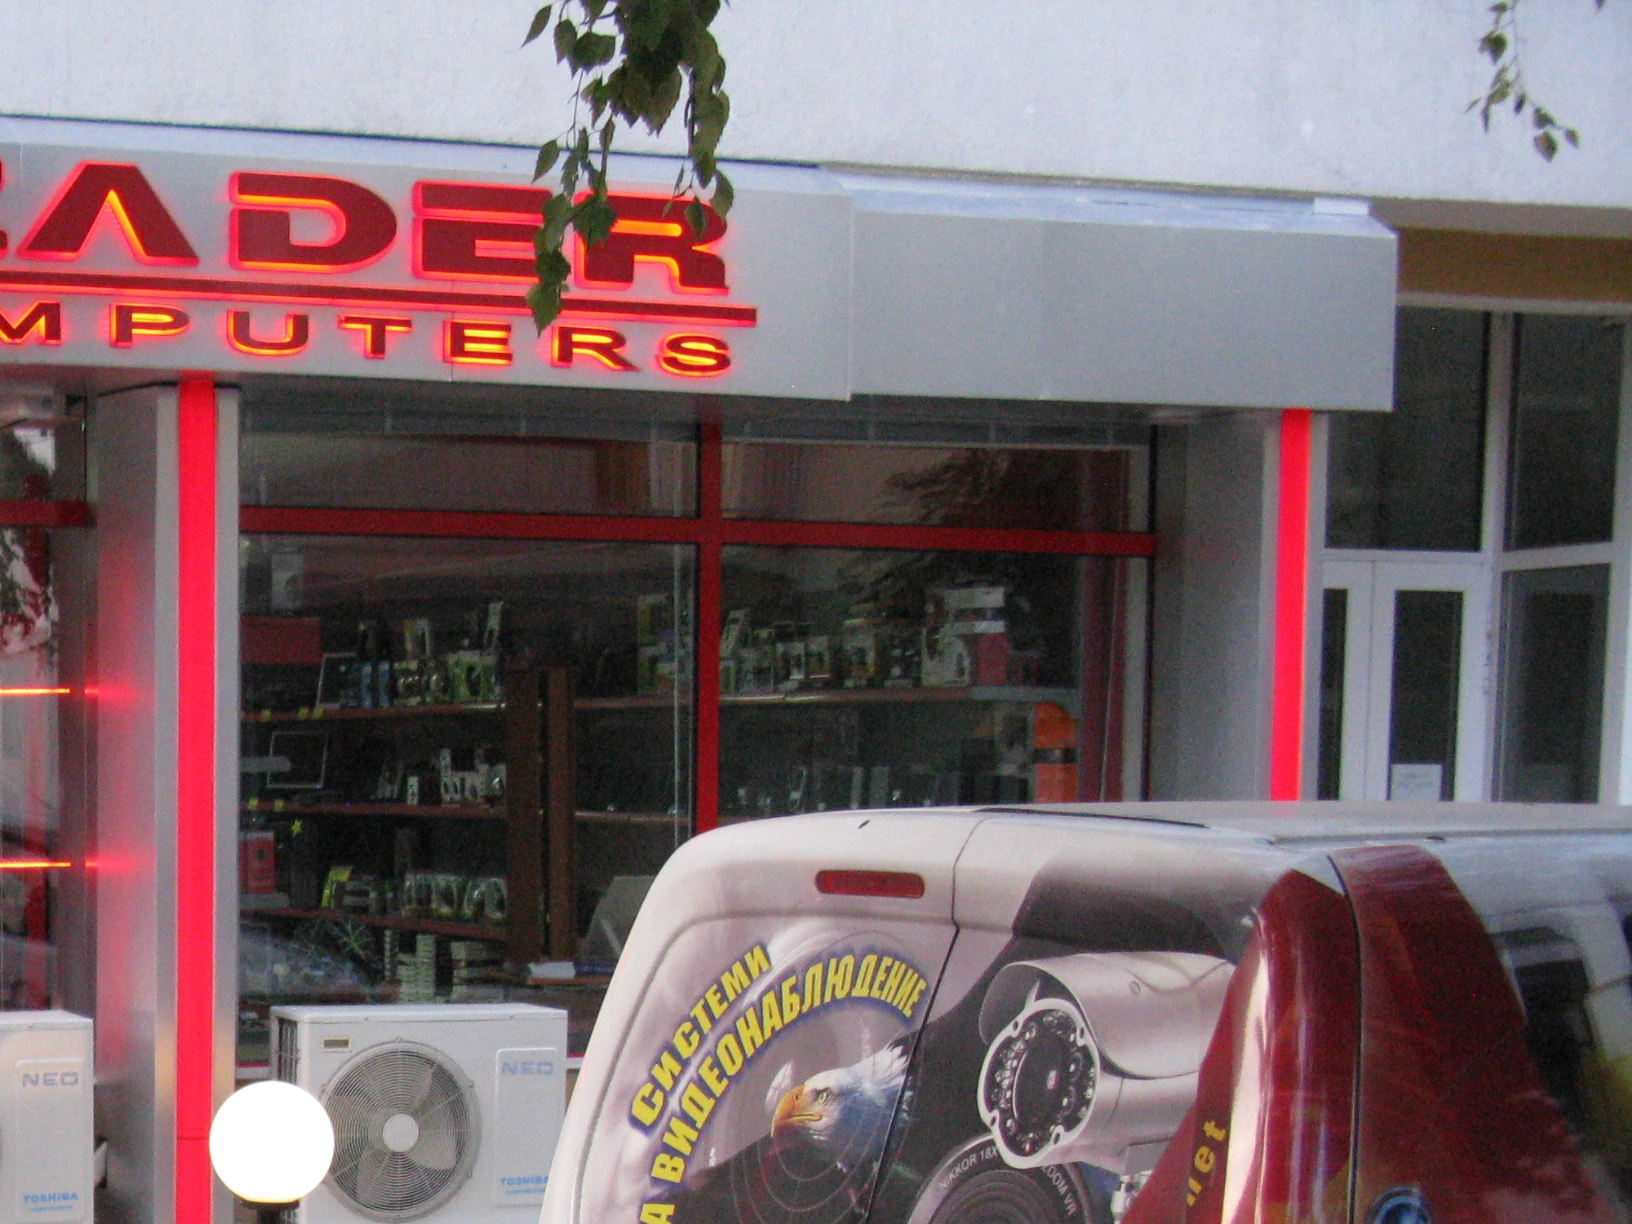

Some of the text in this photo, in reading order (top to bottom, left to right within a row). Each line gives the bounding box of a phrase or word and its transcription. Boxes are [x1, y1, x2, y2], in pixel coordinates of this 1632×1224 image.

[630, 944, 772, 1127] СИСТЕМИ
[501, 1061, 554, 1075] NEO
[650, 953, 927, 1183] ВИДЕОНАБЛЮДЕНИЕ
[22, 1071, 79, 1087] NEO
[23, 1191, 79, 1203] TOSHIBA
